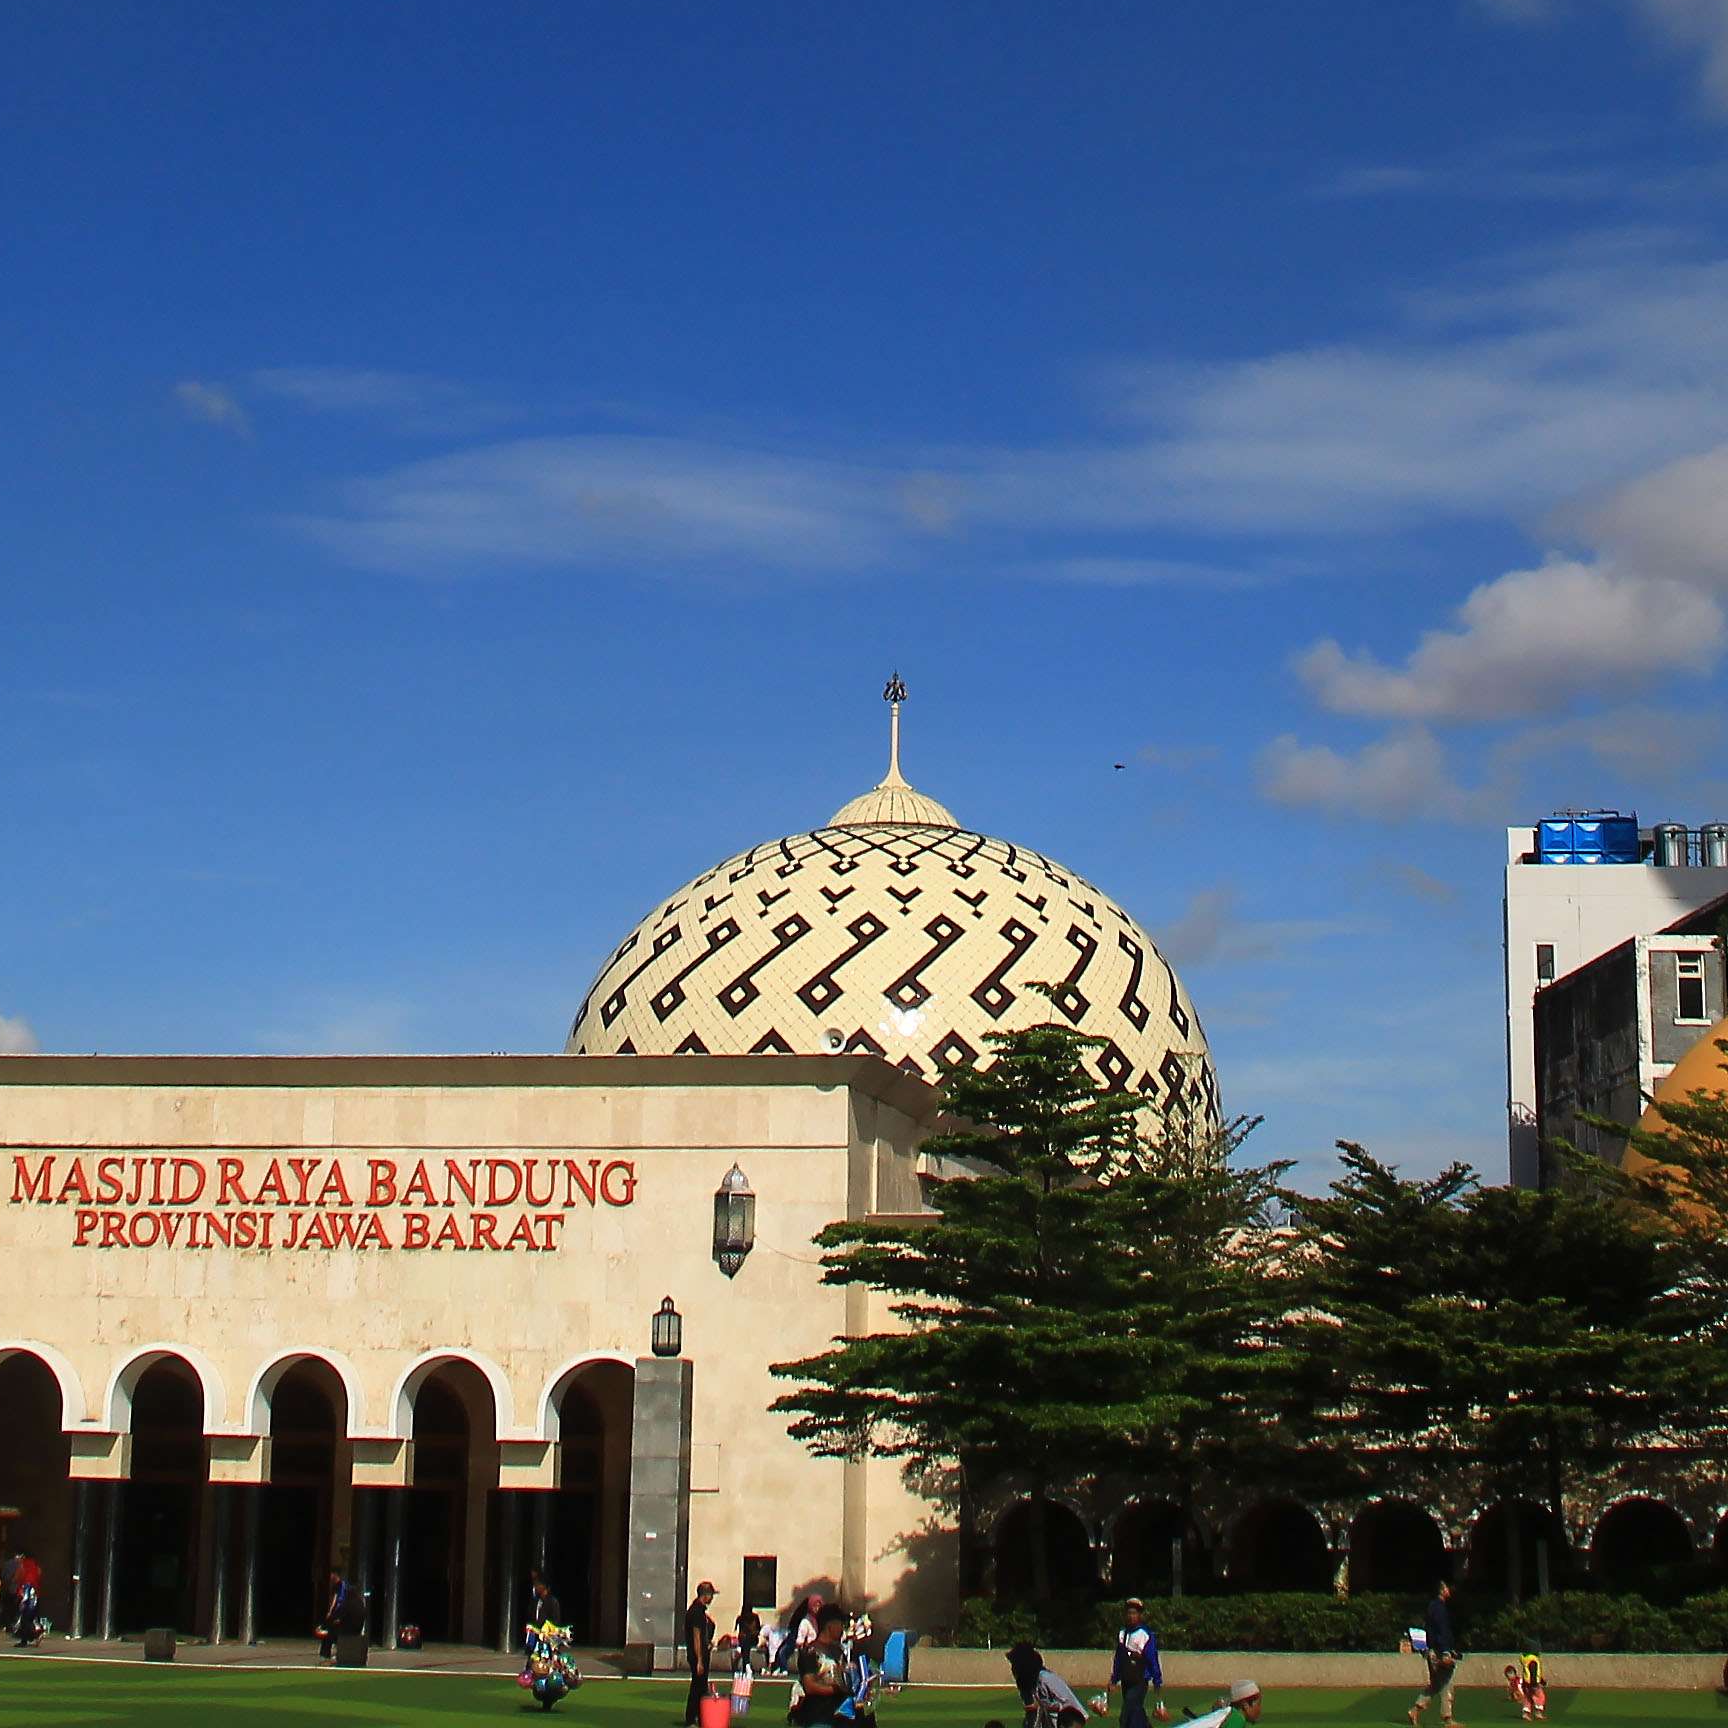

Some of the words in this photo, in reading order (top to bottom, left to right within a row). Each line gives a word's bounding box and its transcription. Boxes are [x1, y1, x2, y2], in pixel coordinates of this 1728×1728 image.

[10, 1155, 206, 1205] MASJID
[216, 1157, 354, 1206] RAYA
[365, 1158, 638, 1208] BANDUNG
[72, 1209, 273, 1249] PROVINSI
[282, 1212, 393, 1250] JAWA
[401, 1212, 565, 1251] BARAT
